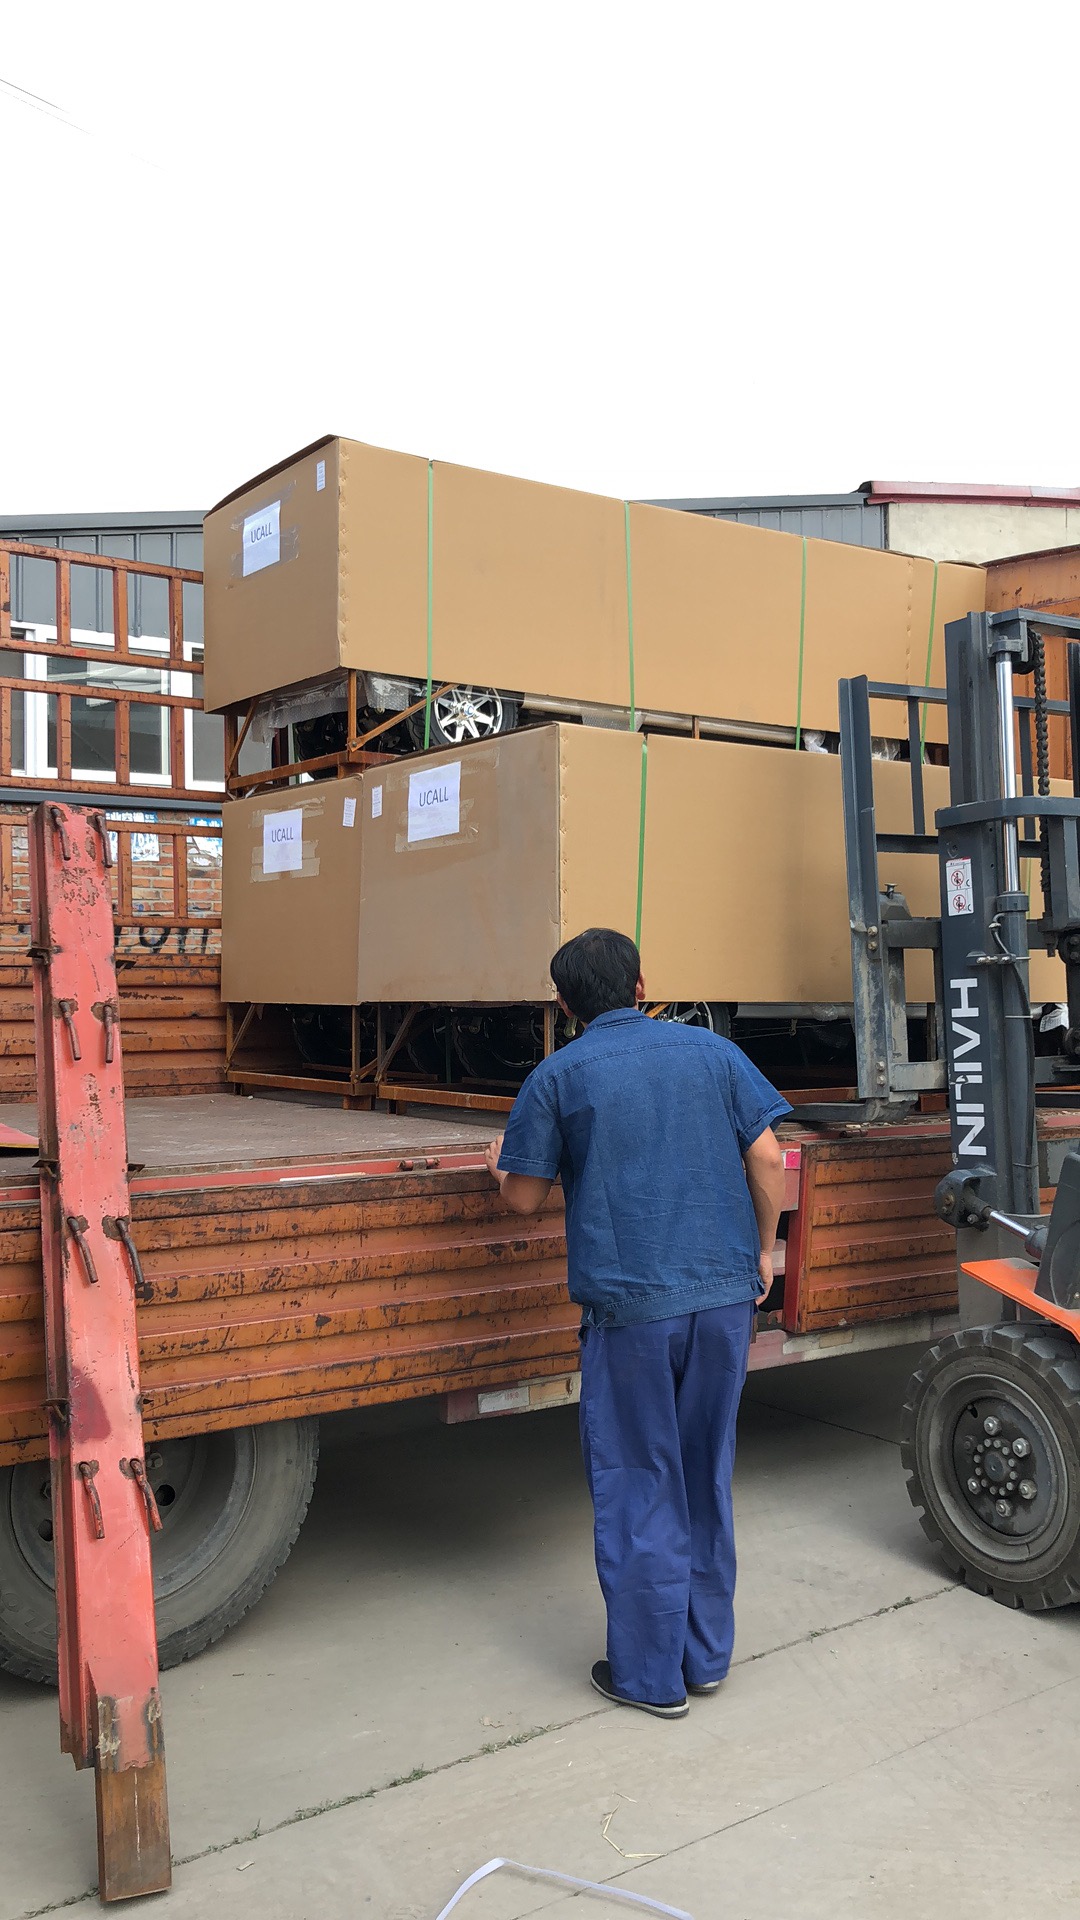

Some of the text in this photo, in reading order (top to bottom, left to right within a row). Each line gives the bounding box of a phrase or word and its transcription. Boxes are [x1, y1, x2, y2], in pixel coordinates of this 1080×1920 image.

[251, 522, 272, 543] UCALL
[419, 787, 449, 807] UCALL
[272, 827, 294, 843] UCALL
